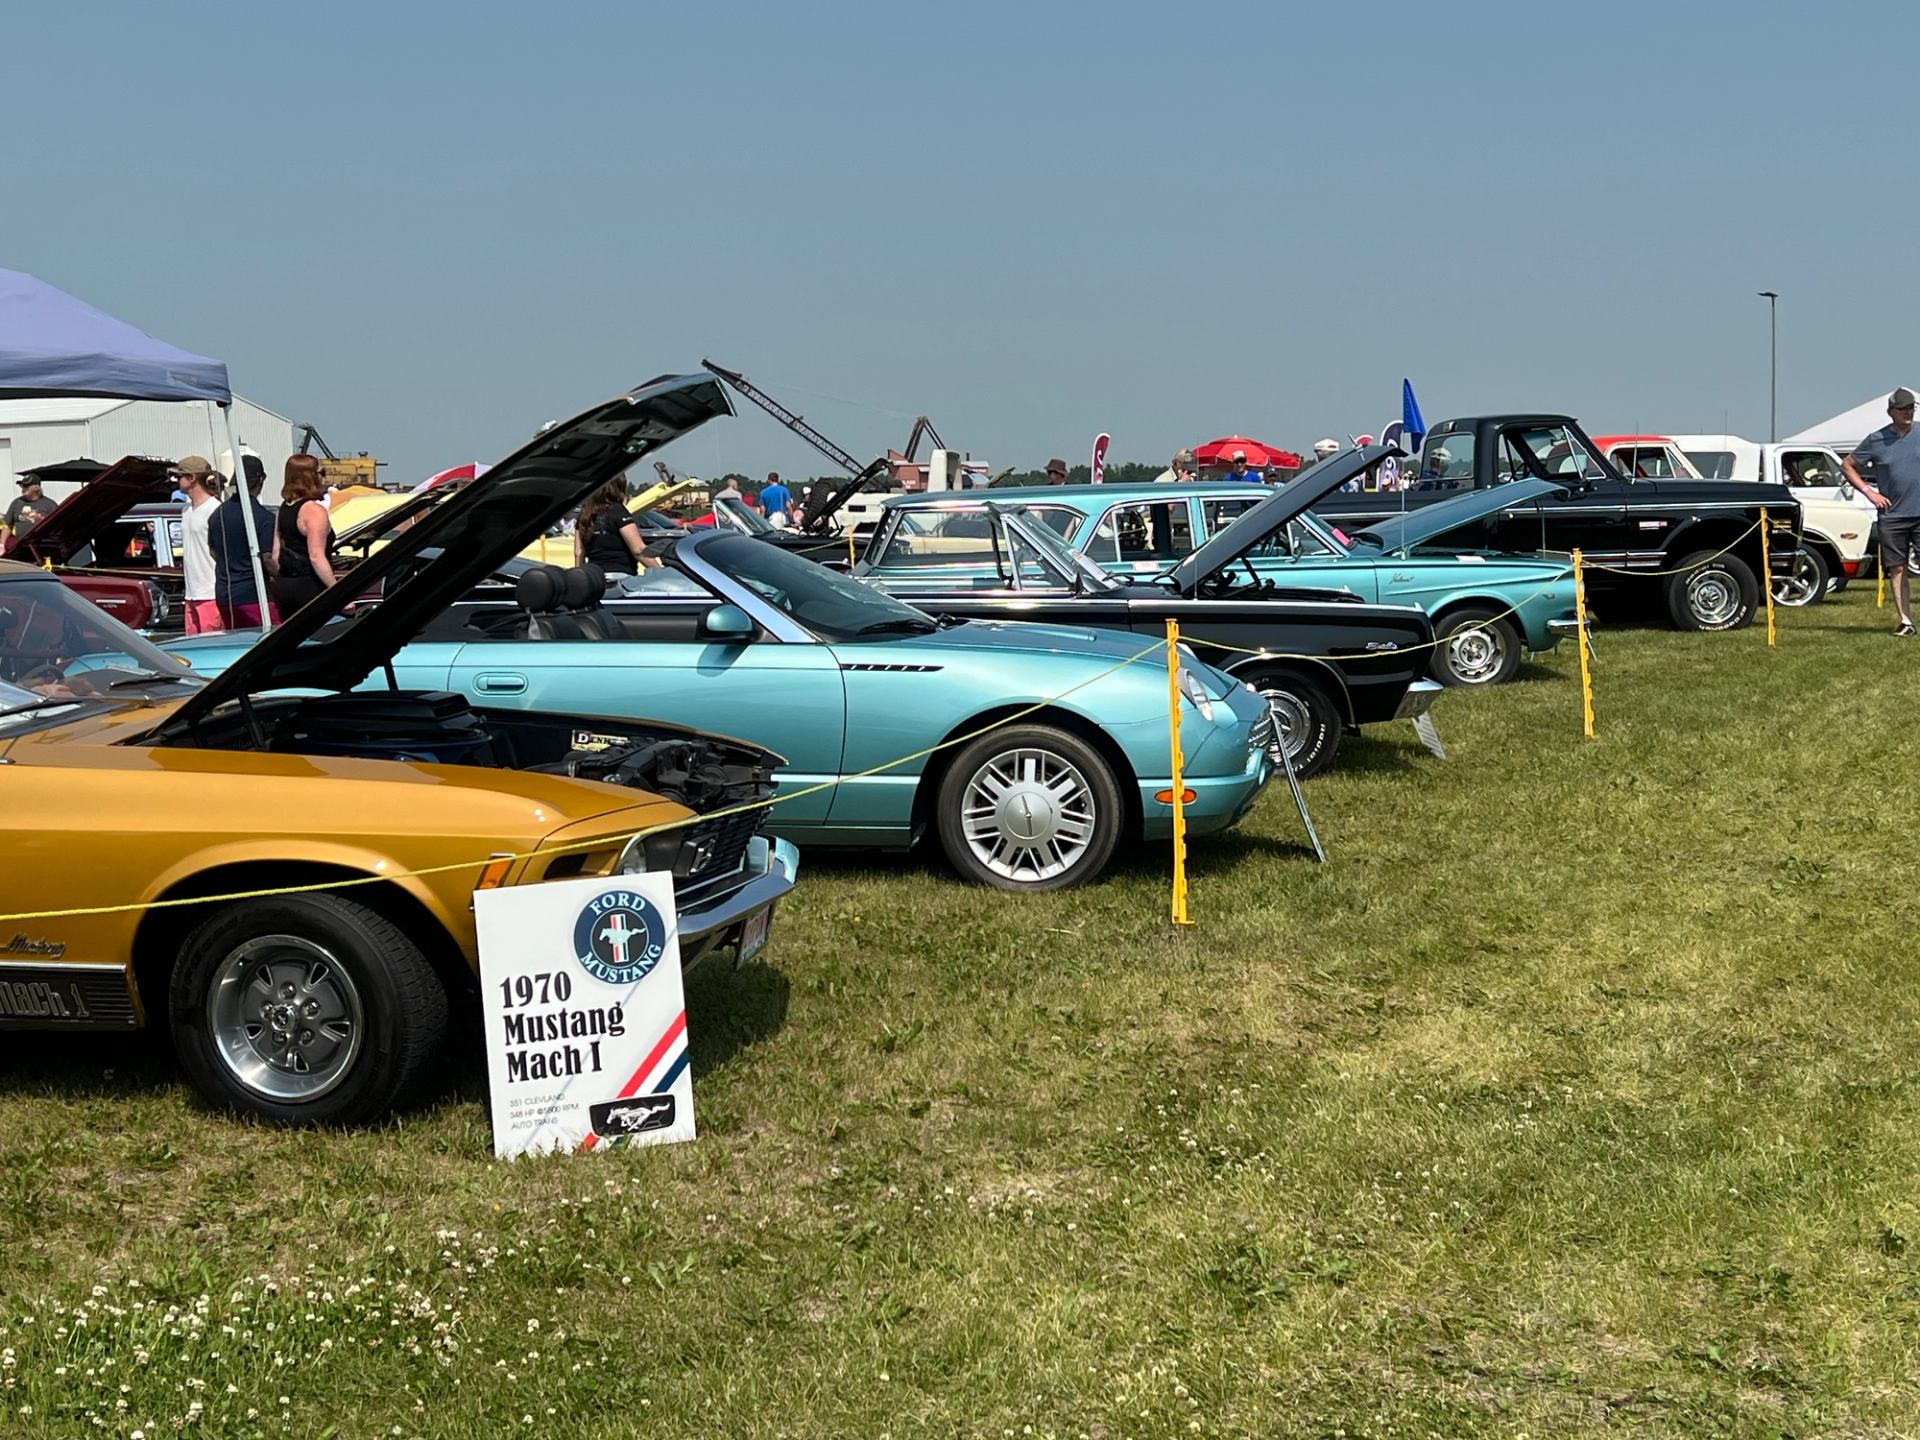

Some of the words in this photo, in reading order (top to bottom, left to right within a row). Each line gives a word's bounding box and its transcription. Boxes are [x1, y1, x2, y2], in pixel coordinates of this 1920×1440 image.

[590, 892, 646, 916] FORD
[580, 943, 663, 983] MUSTANG
[499, 971, 571, 1008] 1970
[503, 1001, 625, 1046] Mustang
[507, 1044, 582, 1083] Mach
[511, 1120, 533, 1130] AUTO
[534, 1117, 559, 1127] TRANS
[525, 1109, 535, 1117] HP
[562, 1103, 579, 1111] RPM
